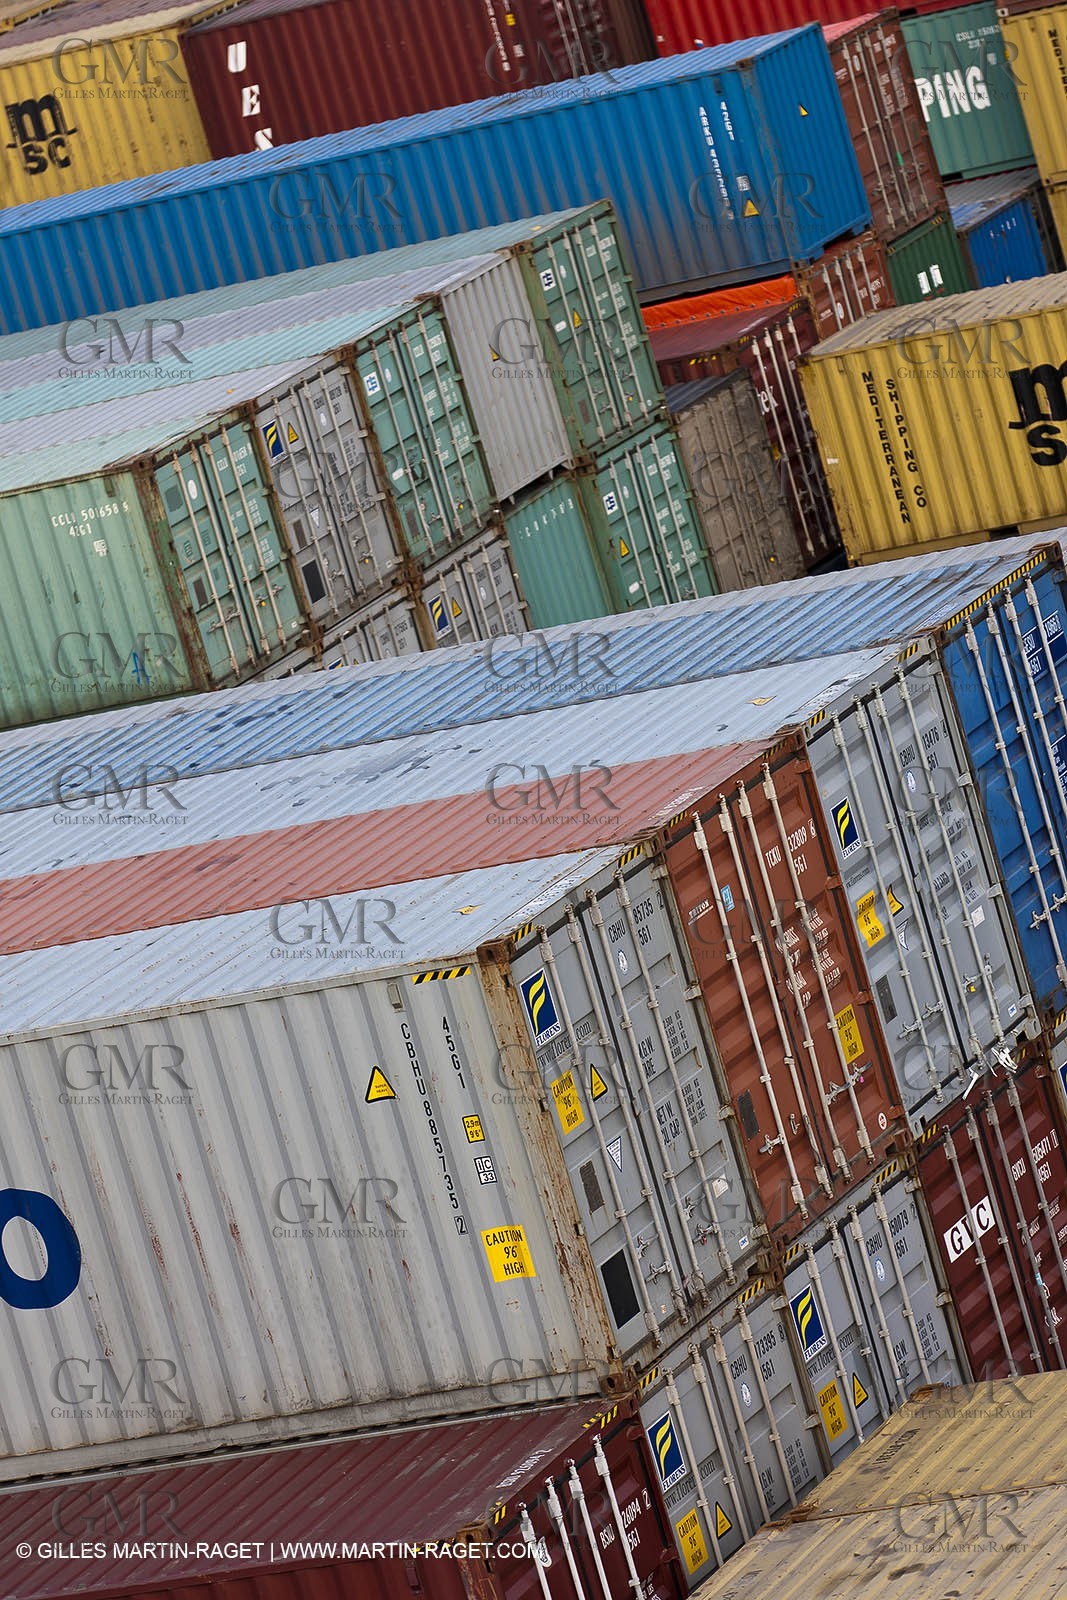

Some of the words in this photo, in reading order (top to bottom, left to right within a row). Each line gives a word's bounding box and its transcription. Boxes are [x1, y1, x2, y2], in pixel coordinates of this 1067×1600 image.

[914, 66, 991, 122] PING
[861, 371, 911, 524] MEDITERRANEAN
[885, 379, 918, 473] SHIPPING
[913, 485, 927, 508] CO
[922, 727, 940, 750] 13476
[927, 752, 939, 771] 5G1
[787, 826, 808, 852] 32809
[794, 854, 808, 876] 5G1
[608, 918, 626, 944] CBHU
[632, 898, 654, 925] 85735
[656, 890, 664, 910] 2
[638, 929, 652, 946] 5G1
[536, 1023, 561, 1047] FLORENS
[442, 1017, 466, 1089] 45G1
[553, 1075, 574, 1097] CAUTION
[401, 1023, 426, 1096] CBHU
[423, 1100, 459, 1209] 885735
[456, 1217, 466, 1234] 2
[566, 1110, 579, 1128] HIGH
[482, 1172, 495, 1182] 33
[486, 1230, 523, 1247] CAUTION
[866, 1232, 882, 1257] CBHU
[896, 1239, 909, 1260] 5G1
[503, 1262, 526, 1276] HIGH
[730, 1355, 747, 1380] CBHU
[754, 1331, 776, 1359] 73395
[805, 1337, 827, 1360] FLORENS
[762, 1360, 775, 1382] 5G1
[819, 1385, 837, 1408] CAUTION
[663, 1467, 686, 1491] FLORENS
[622, 1498, 641, 1528] 26094
[678, 1514, 698, 1536] CAUTION
[628, 1530, 640, 1552] 5G1
